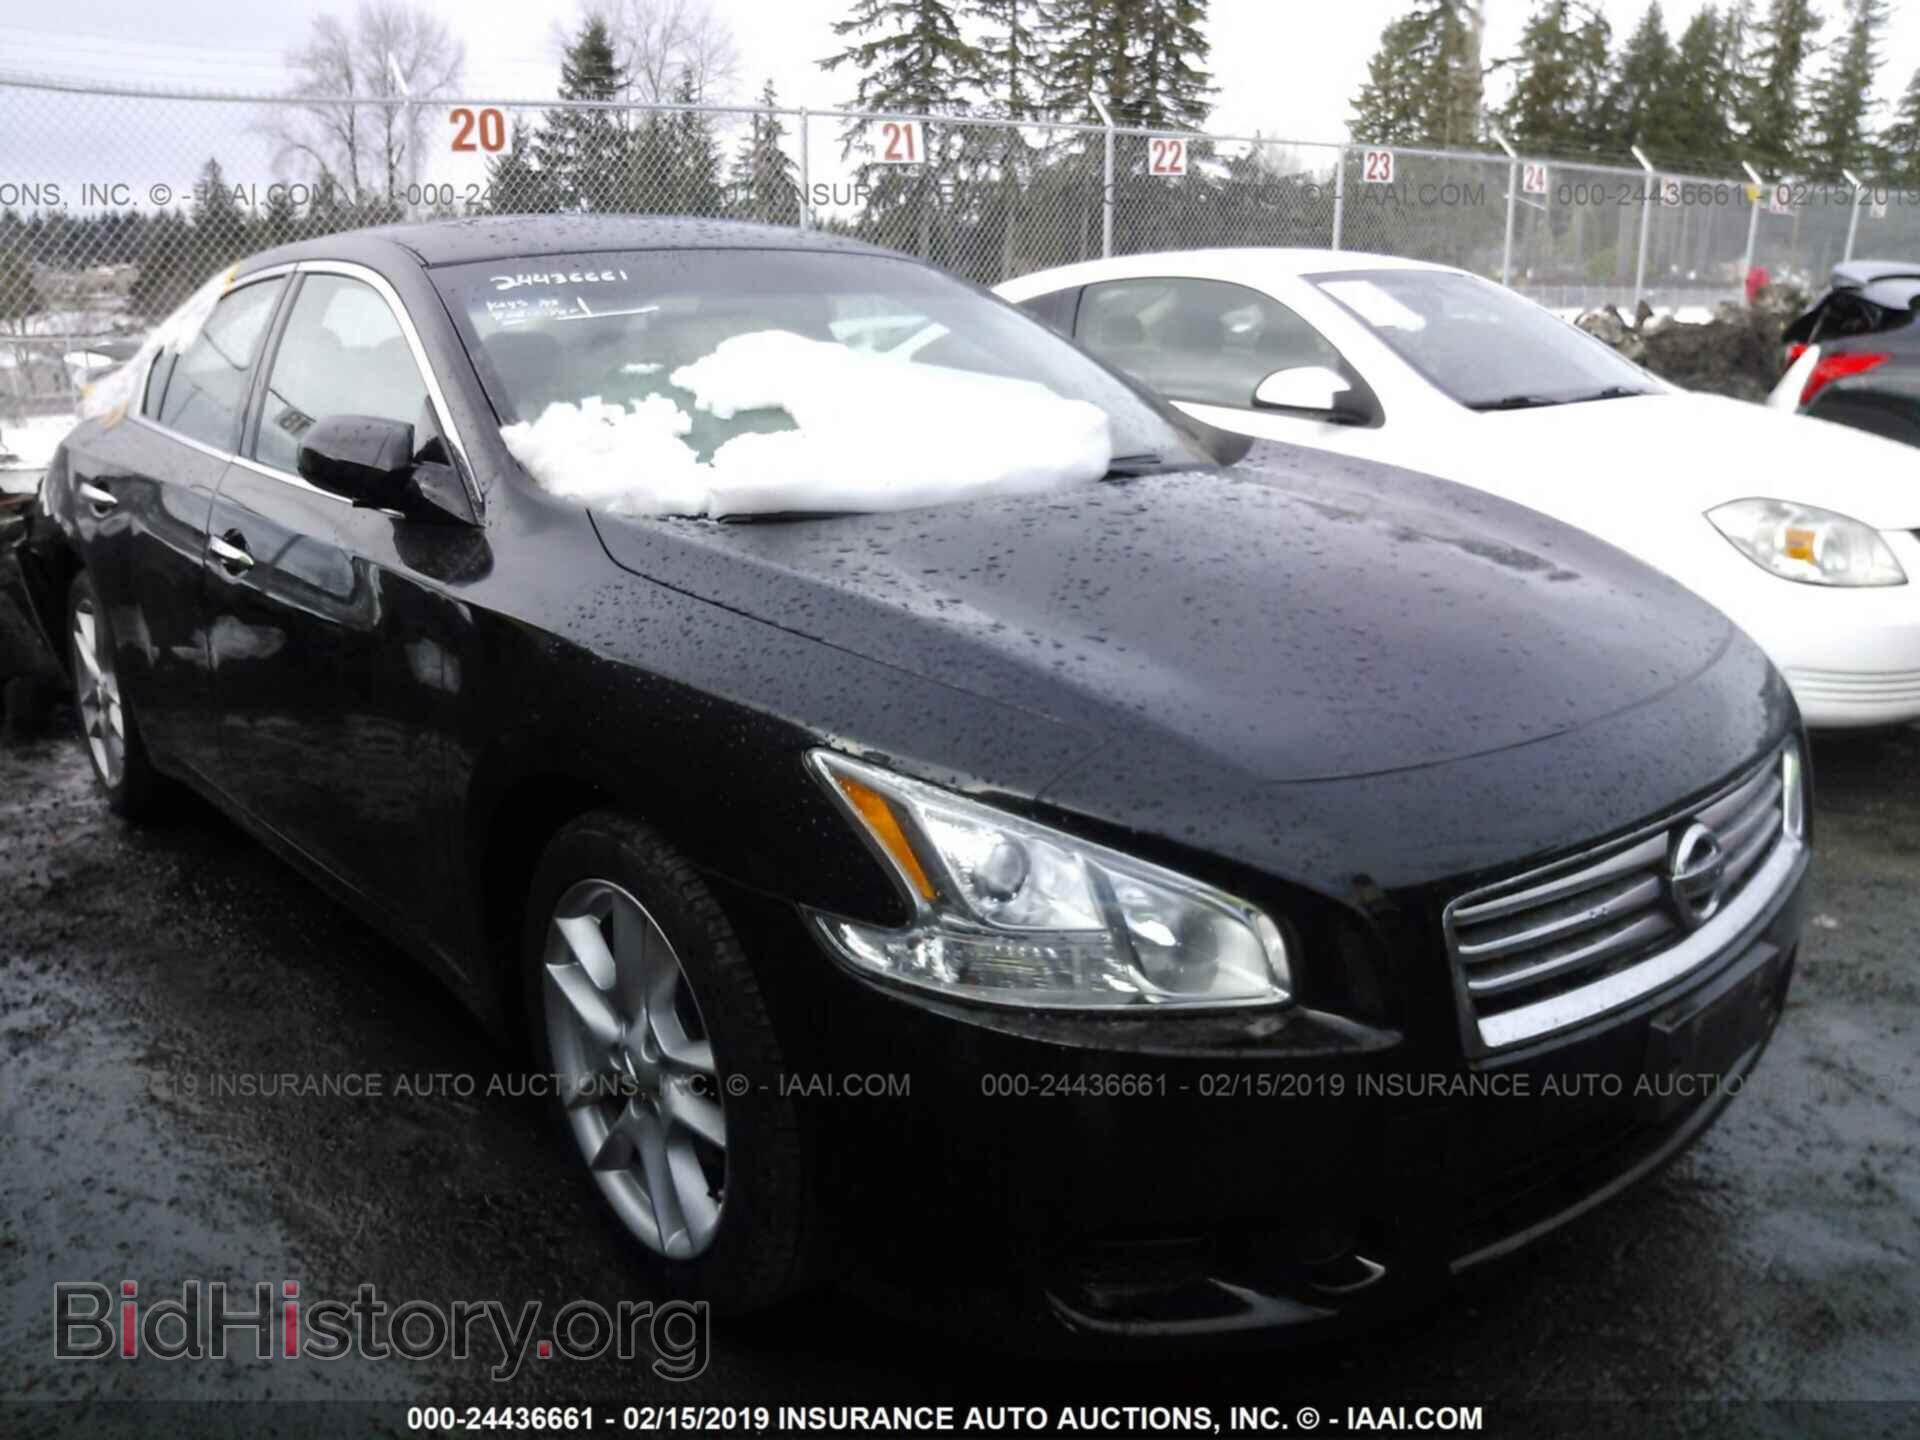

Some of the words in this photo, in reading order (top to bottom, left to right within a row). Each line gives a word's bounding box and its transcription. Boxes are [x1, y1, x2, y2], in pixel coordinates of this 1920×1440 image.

[449, 108, 505, 152] 20
[882, 122, 914, 161] 21
[1153, 140, 1182, 173] 22
[1367, 152, 1390, 181] 23
[1526, 166, 1544, 191] 24
